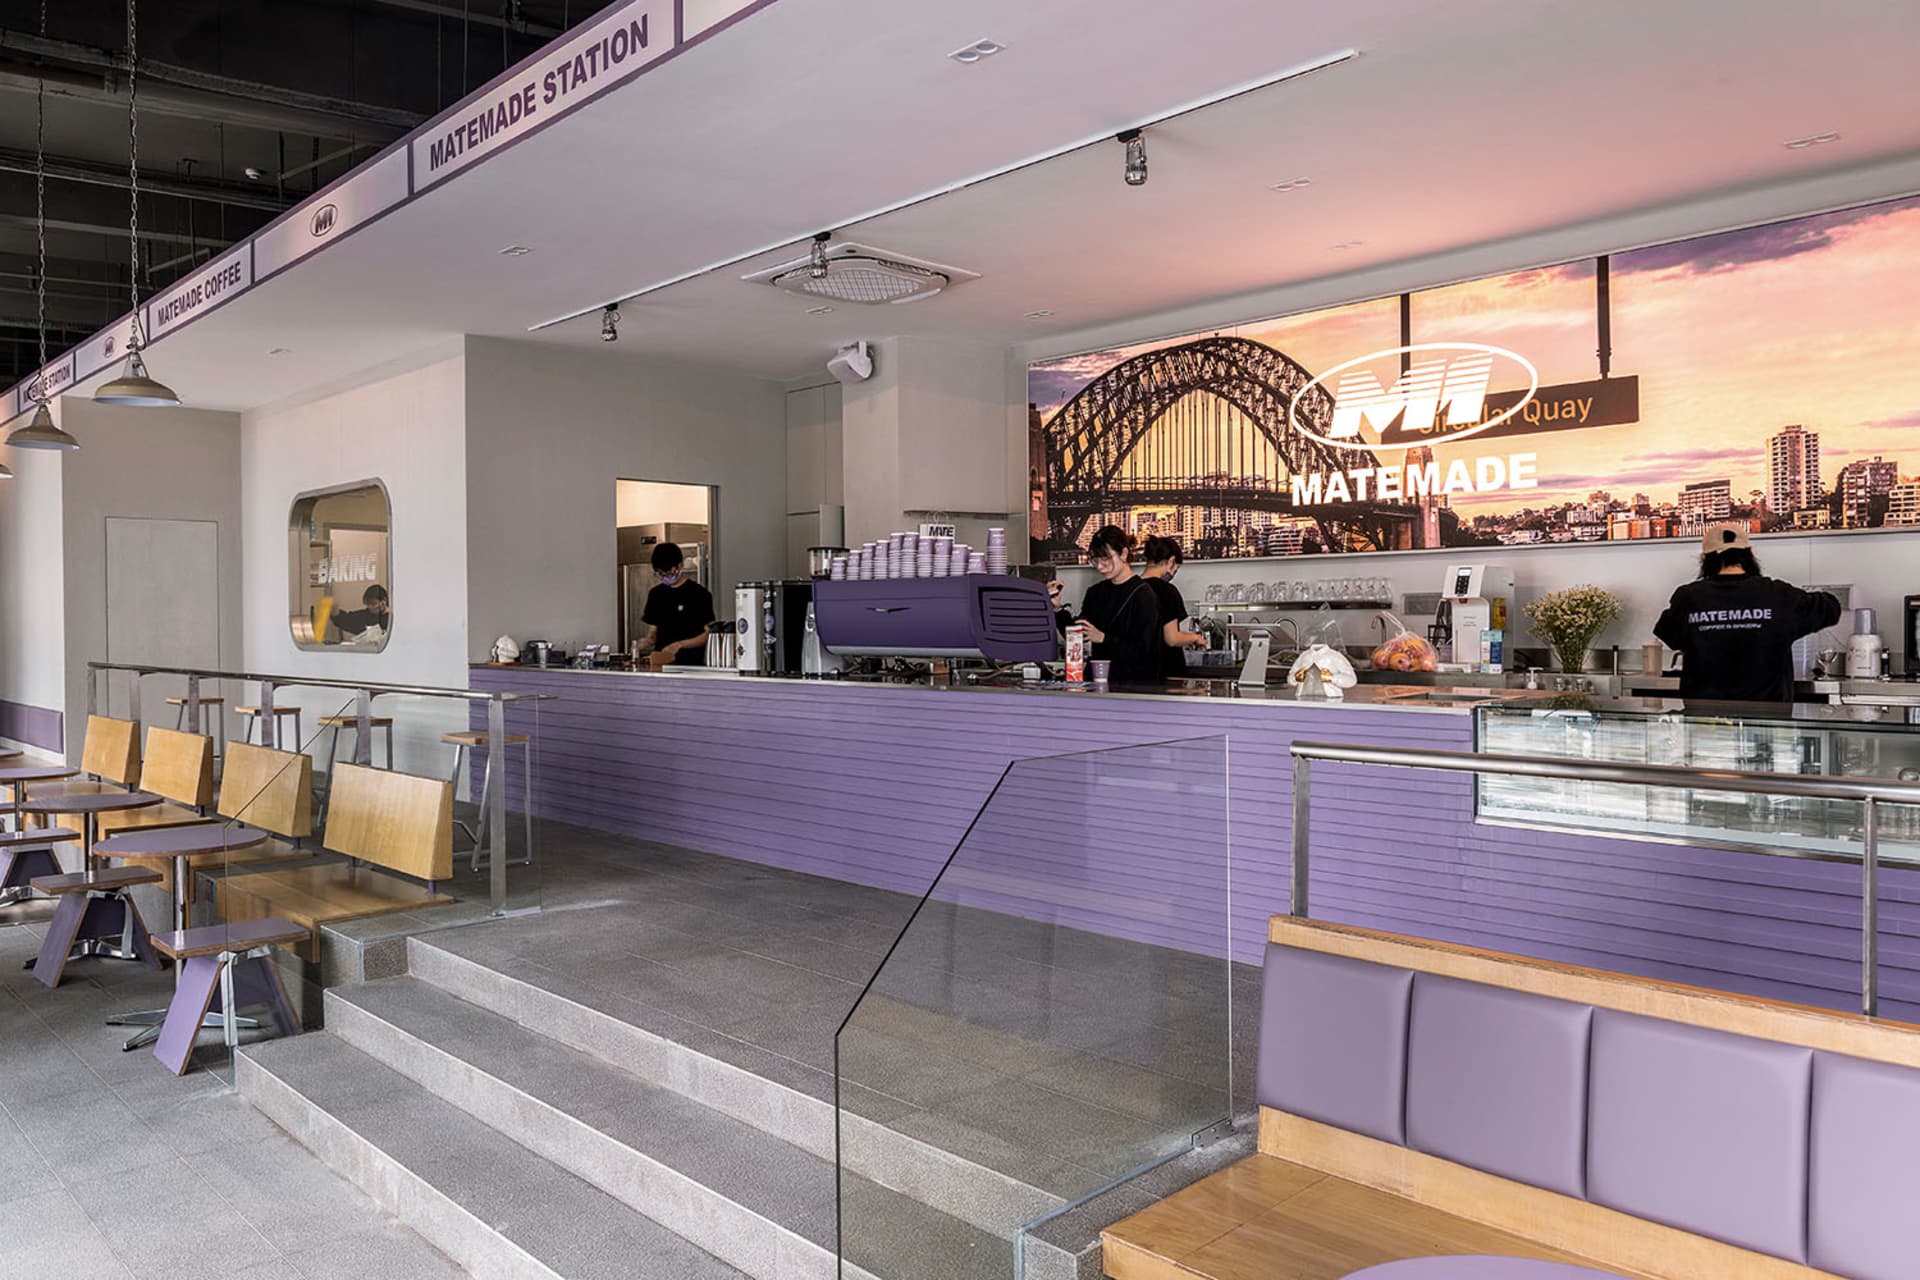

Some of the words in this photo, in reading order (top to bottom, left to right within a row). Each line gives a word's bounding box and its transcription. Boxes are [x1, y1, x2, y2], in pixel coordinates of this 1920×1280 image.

[430, 82, 536, 171] MATEMADE
[543, 13, 648, 105] STATION
[157, 284, 203, 327] MATEMADE
[204, 261, 241, 299] COFFEE
[1522, 397, 1593, 426] Quay
[1292, 452, 1538, 506] MATEMADE
[318, 553, 377, 584] BAKING
[1688, 608, 1772, 624] MATEMADE
